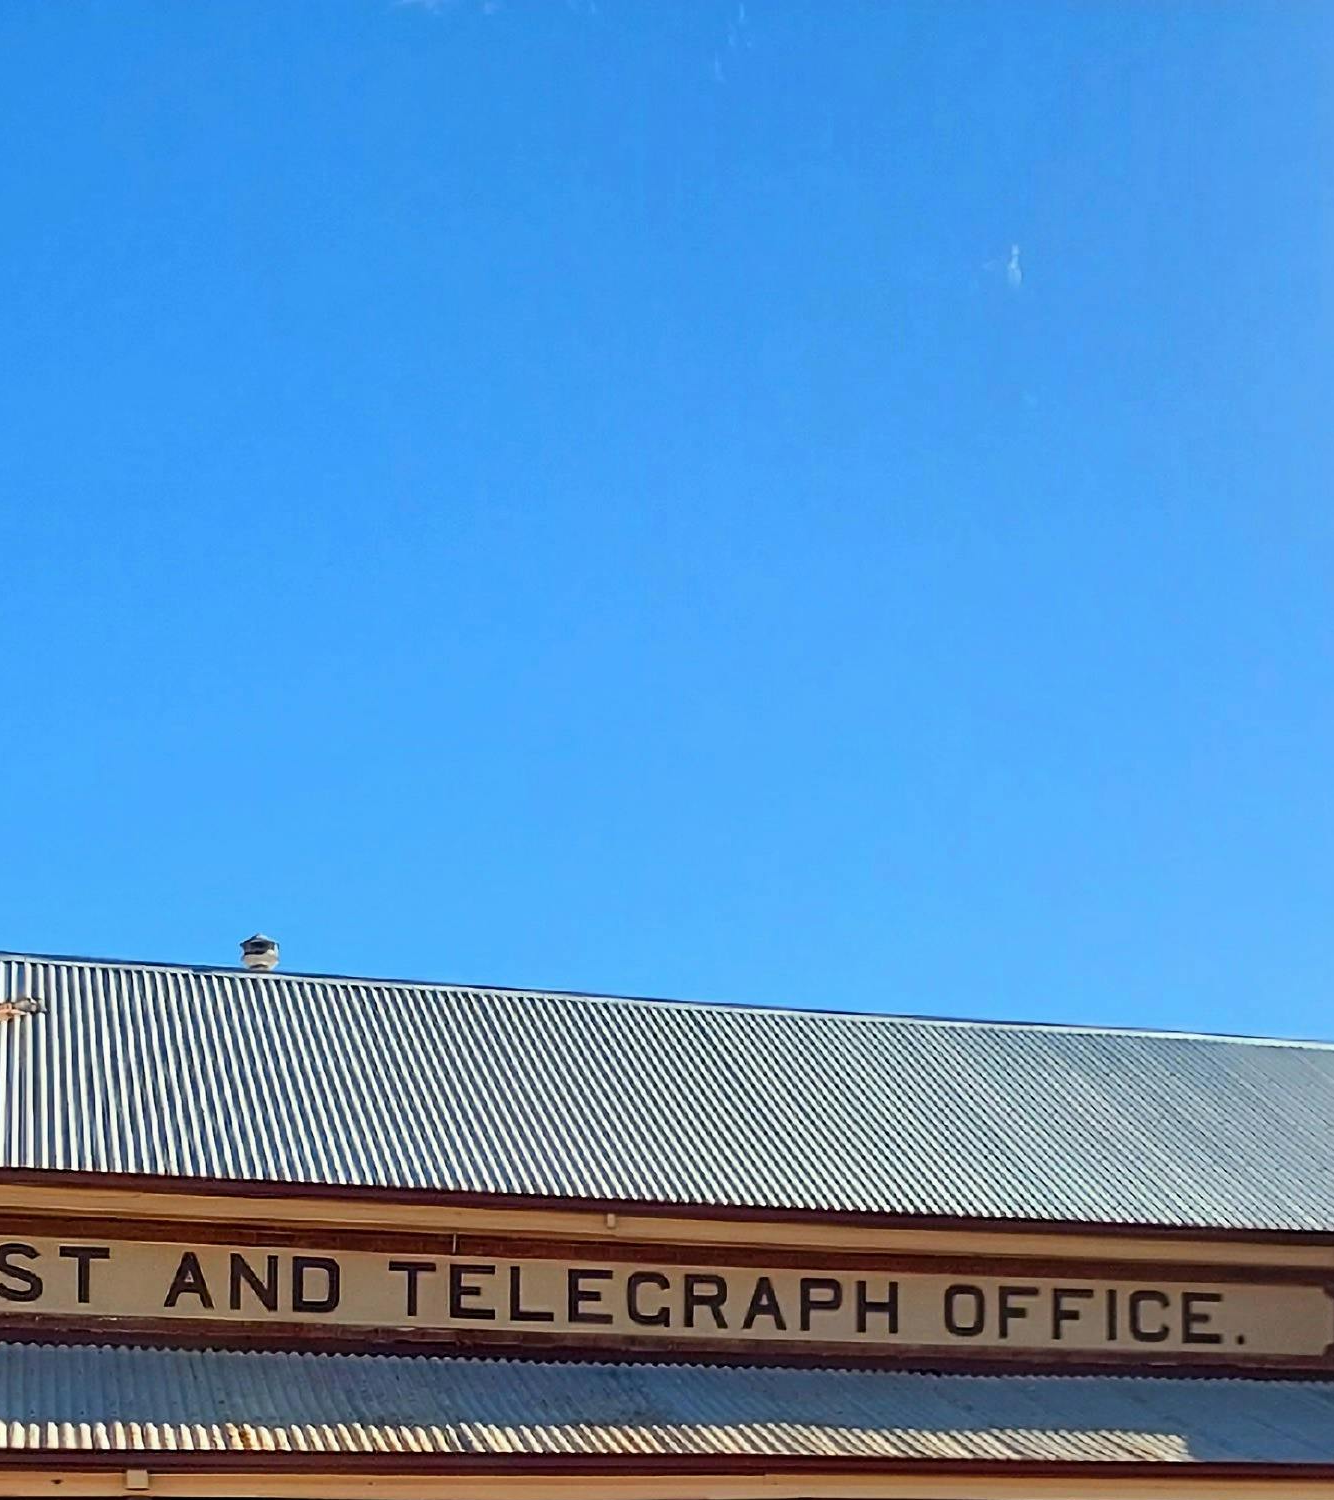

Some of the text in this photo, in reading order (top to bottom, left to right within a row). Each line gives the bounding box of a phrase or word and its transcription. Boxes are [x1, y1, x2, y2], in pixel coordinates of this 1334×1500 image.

[163, 1251, 341, 1313] AND
[388, 1260, 899, 1334] TELEGRAPH
[943, 1283, 1247, 1345] OFFICE.
